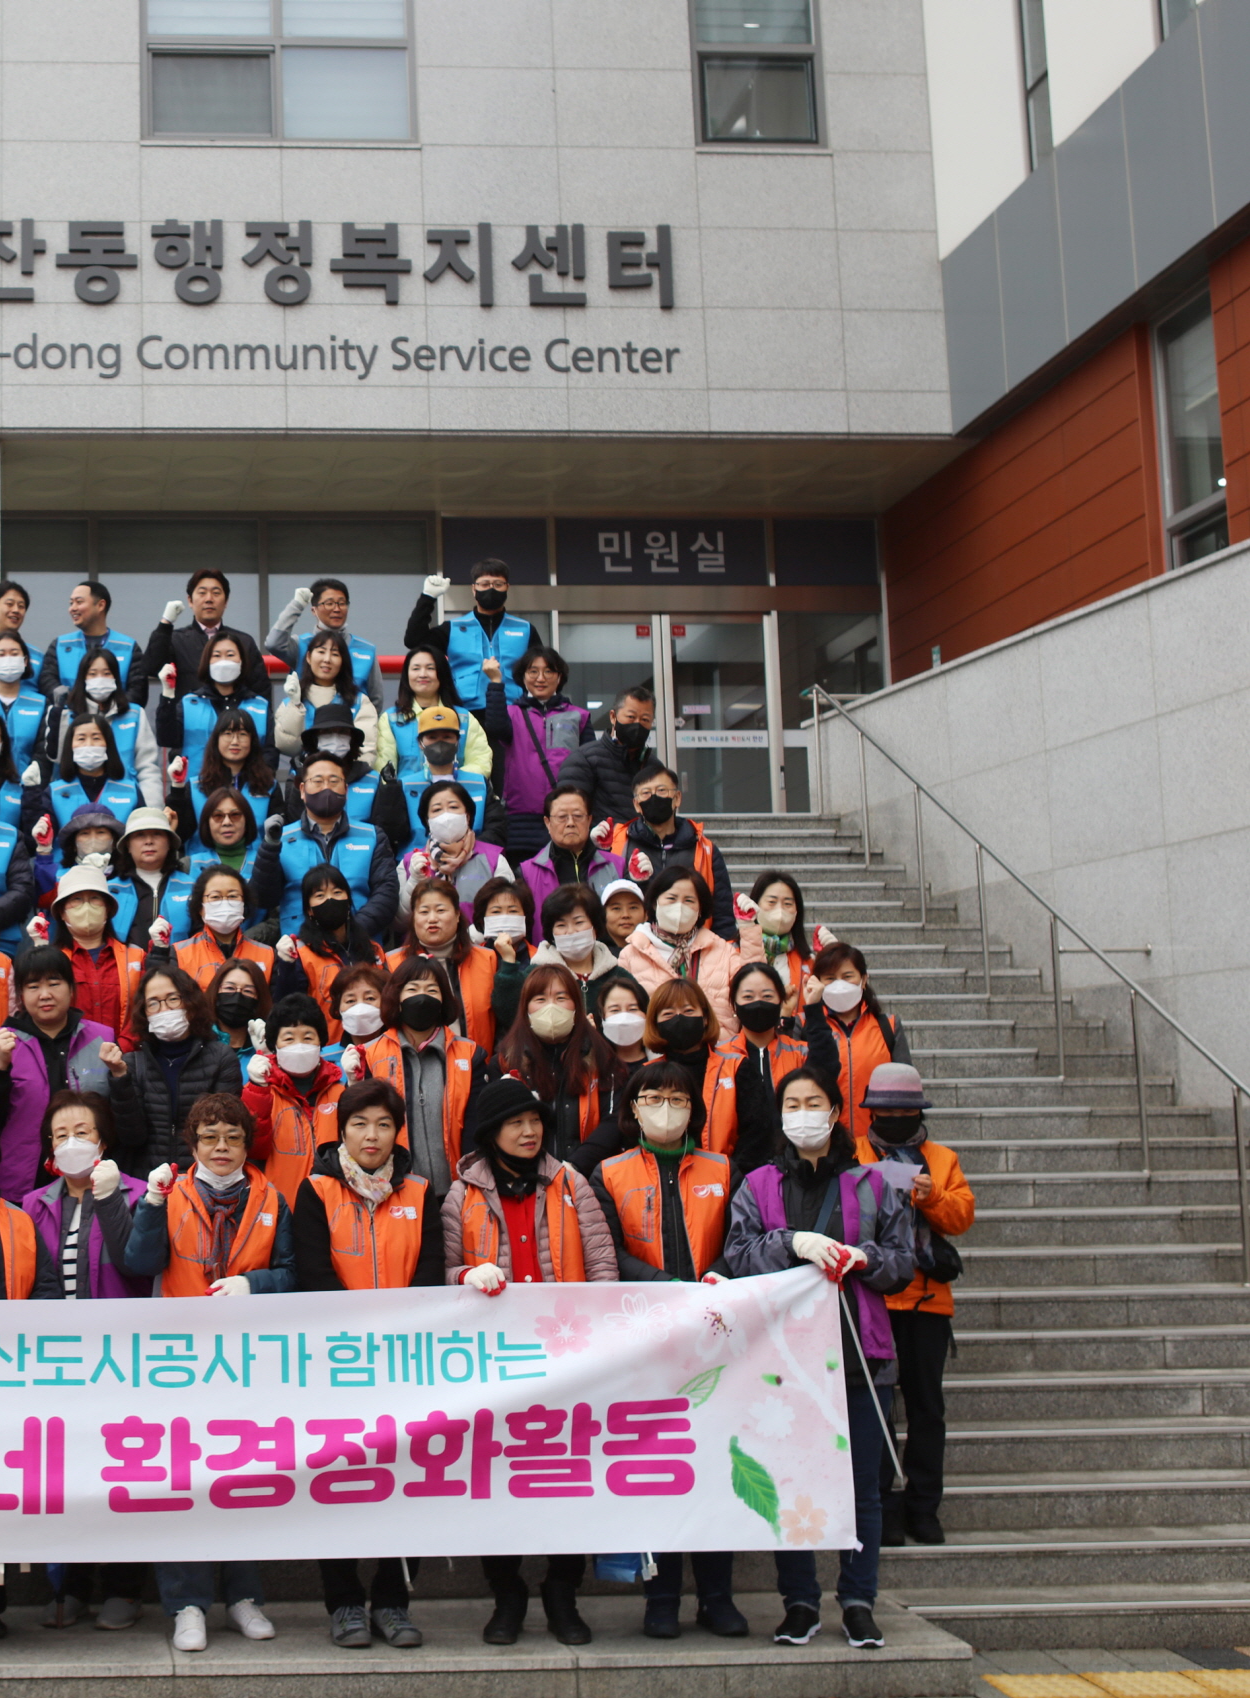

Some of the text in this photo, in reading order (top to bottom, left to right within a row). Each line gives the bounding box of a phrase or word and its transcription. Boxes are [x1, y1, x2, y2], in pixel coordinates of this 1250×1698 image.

[136, 335, 380, 380] Community
[390, 337, 532, 373] Service
[544, 338, 681, 375] Center
[597, 530, 727, 574] 민원실
[325, 1329, 548, 1388] 함께하는
[101, 1397, 698, 1514] 환경정화활동
